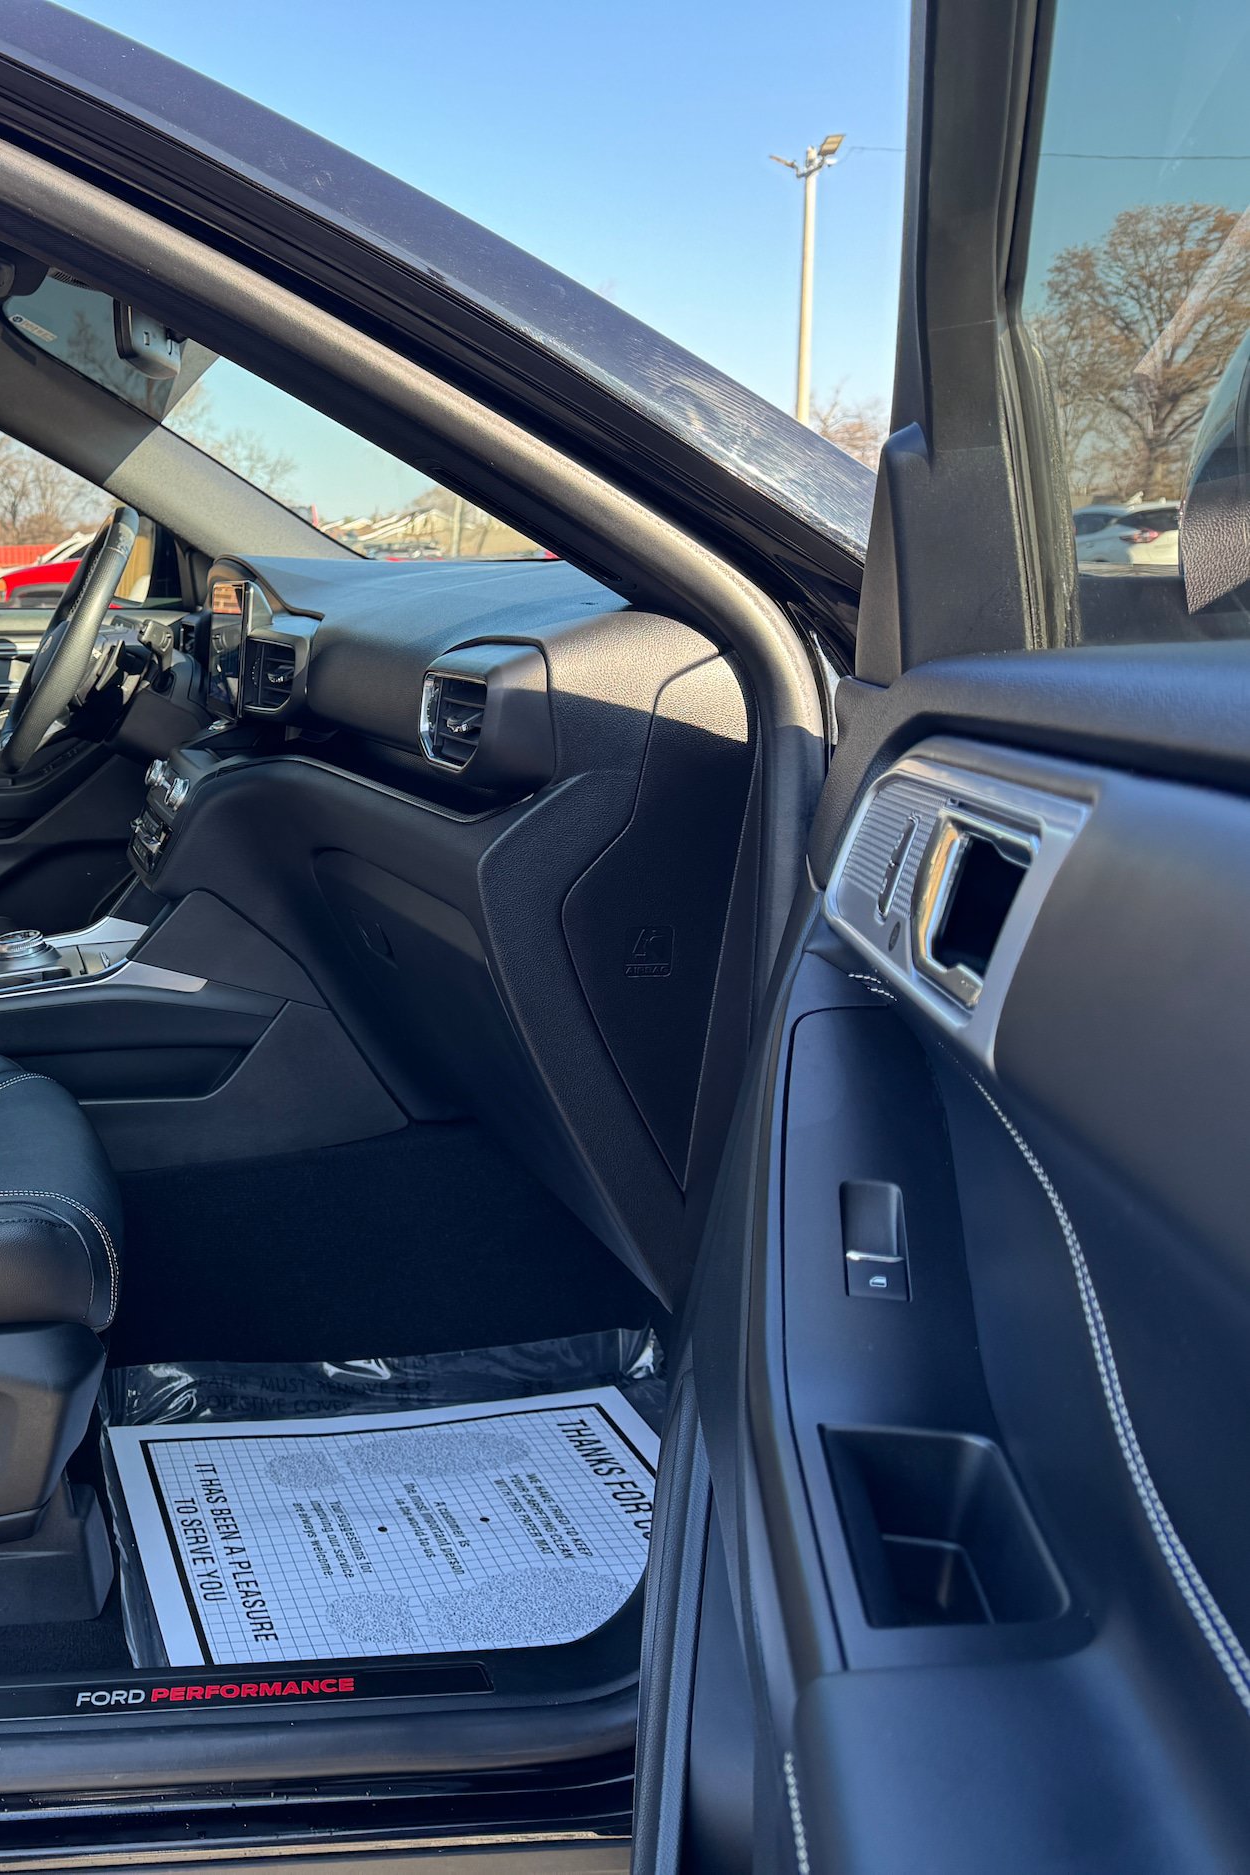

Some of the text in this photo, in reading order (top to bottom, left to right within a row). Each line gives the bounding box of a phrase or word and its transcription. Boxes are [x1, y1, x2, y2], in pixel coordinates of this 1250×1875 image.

[625, 966, 669, 975] AIRBAG
[260, 1375, 307, 1394] MUST
[556, 1418, 625, 1476] THANKS
[603, 1480, 653, 1514] FOR
[292, 1502, 305, 1512] are
[298, 1513, 317, 1538] always
[407, 1517, 428, 1537] world
[418, 1538, 430, 1547] to
[438, 1507, 465, 1538] customer
[458, 1539, 470, 1548] is
[493, 1479, 555, 1555] WITH THIS PAPER MAT
[509, 1473, 576, 1559] YOUR CARPETING CLEAN
[526, 1473, 594, 1557] WE HAVE TRIED TO KEEP
[174, 1497, 228, 1602] TO SERVE YOU
[194, 1463, 279, 1643] IT HAS BEEN A PLEASURE
[327, 1534, 341, 1548] our
[334, 1549, 355, 1579] service
[336, 1514, 367, 1561] suggestions
[359, 1562, 373, 1573] for
[410, 1495, 430, 1512] most
[421, 1512, 452, 1547] important
[440, 1547, 465, 1575] person
[76, 1677, 355, 1707] FORD PERFORMANCE
